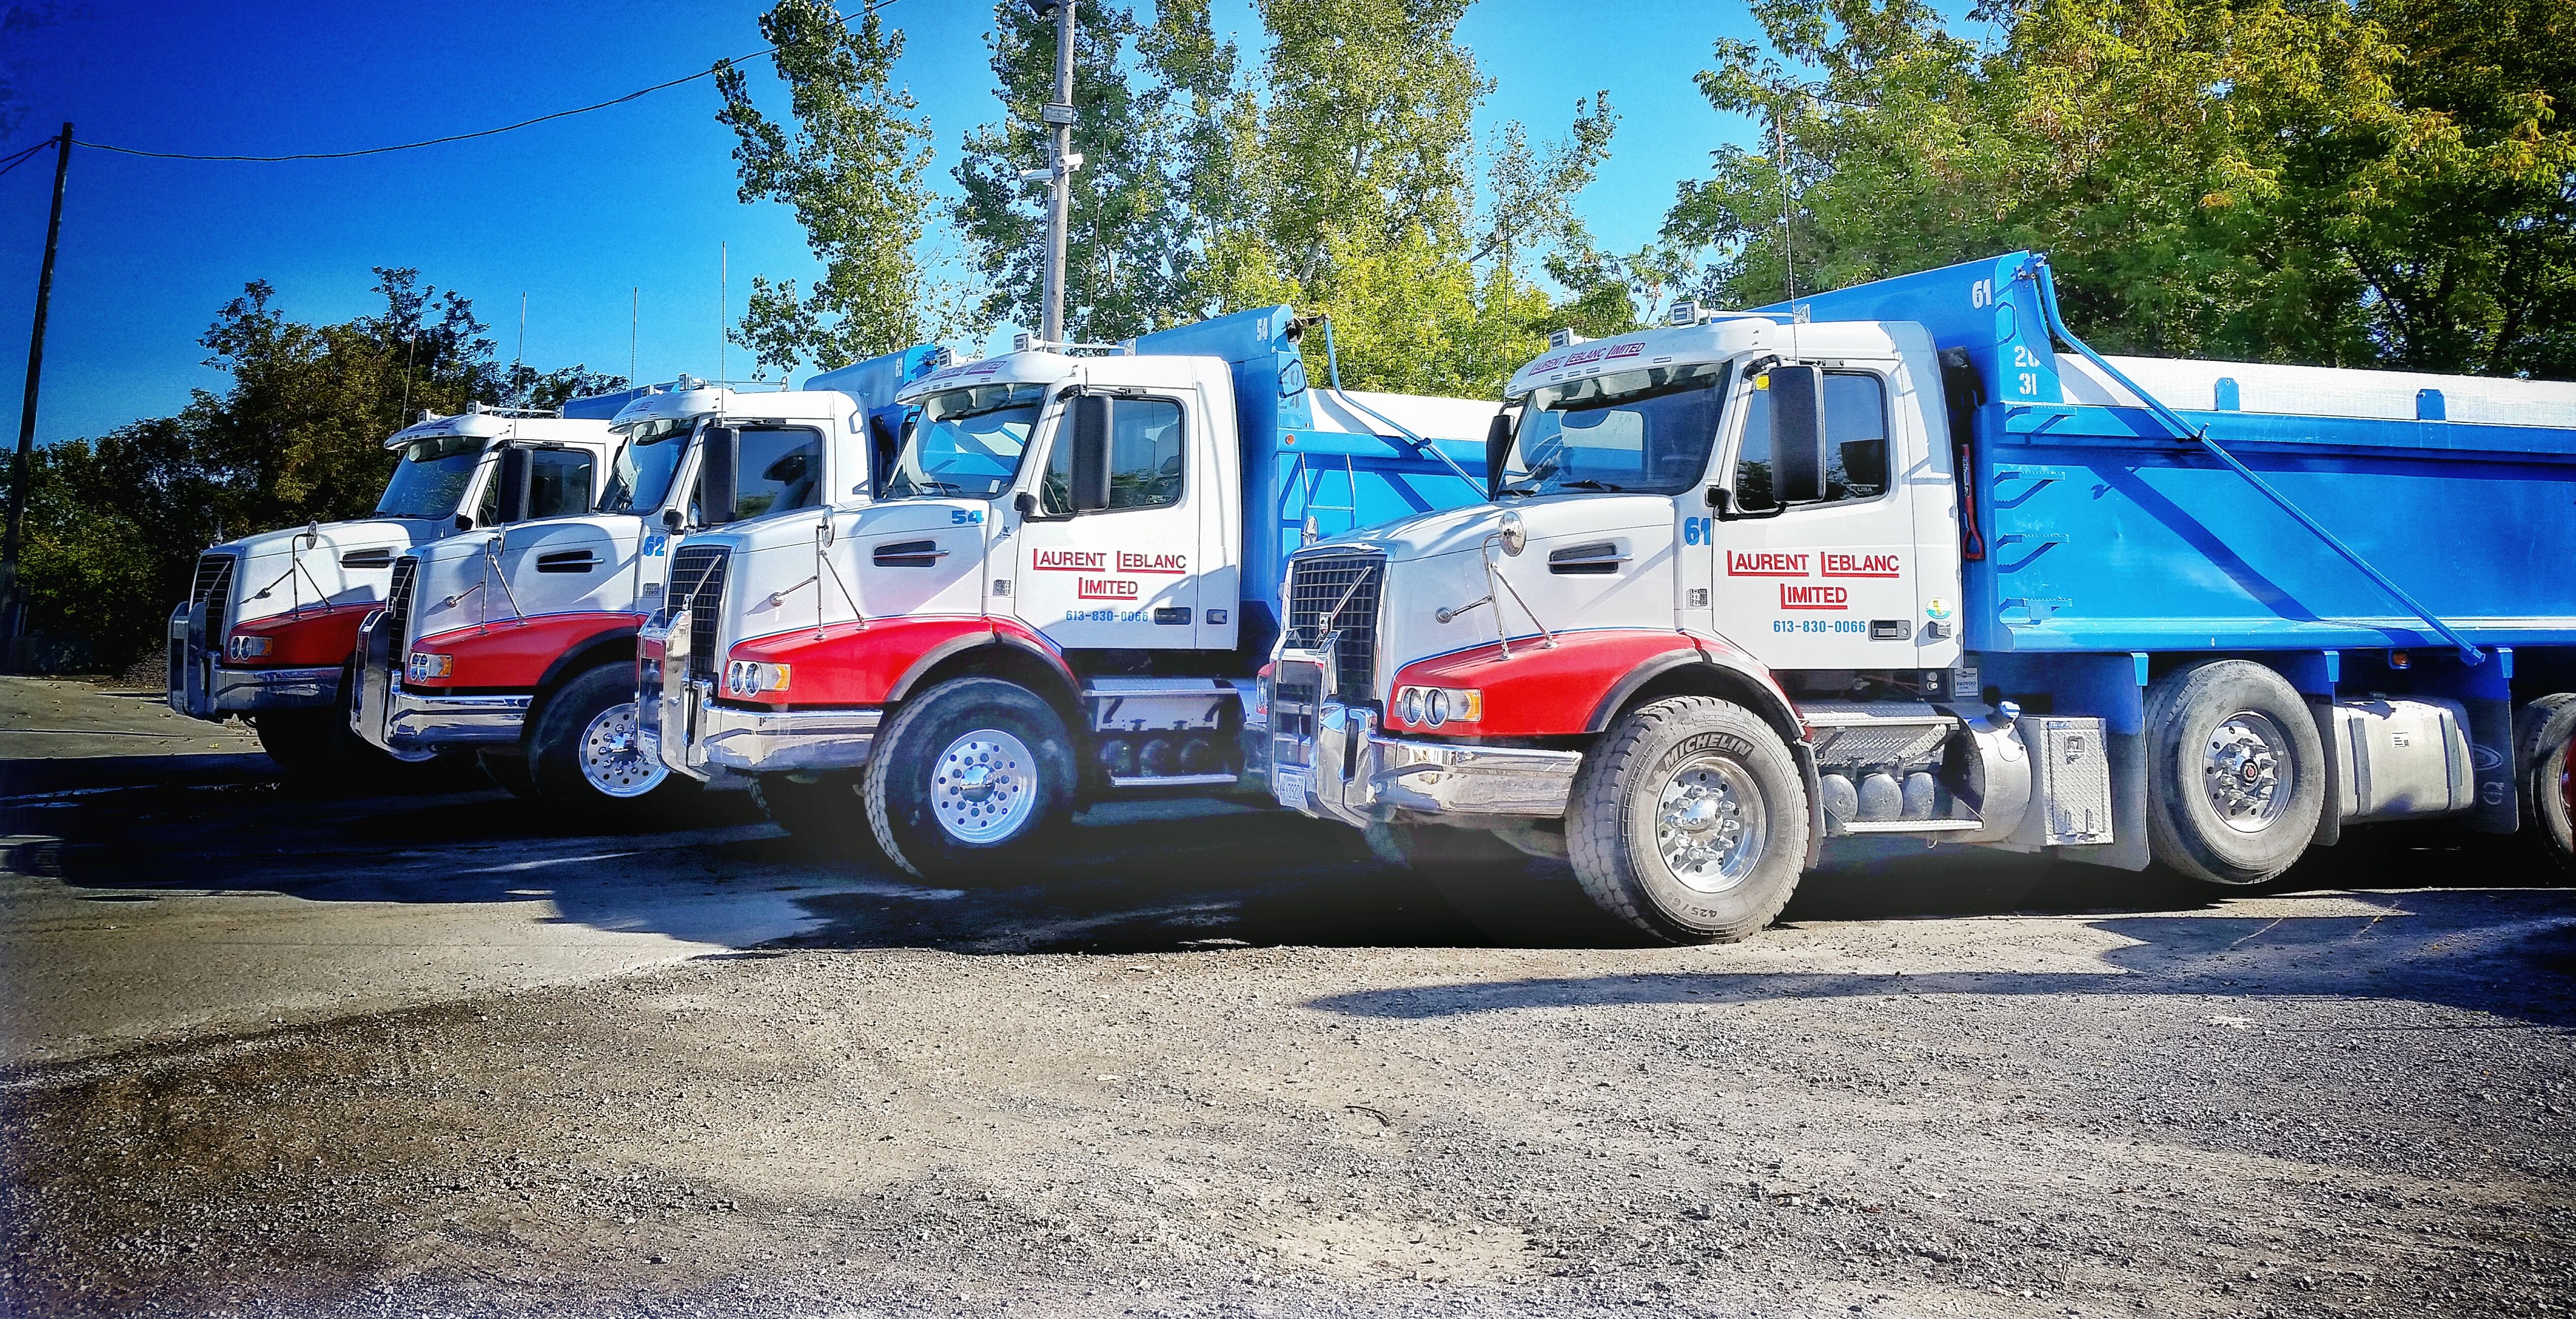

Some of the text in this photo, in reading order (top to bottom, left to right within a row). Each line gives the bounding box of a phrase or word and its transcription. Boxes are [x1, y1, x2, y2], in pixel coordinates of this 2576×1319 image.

[1972, 278, 1992, 309] 61
[1257, 318, 1268, 342] 54
[895, 357, 903, 378] 62
[1528, 342, 1646, 377] LAURENT LEBLANC LIMITED
[2019, 373, 2037, 395] 31
[952, 510, 984, 524] 54
[1685, 517, 1711, 545] 61
[643, 536, 665, 556] 62
[1034, 548, 1187, 574] LAURENT LEBLANC
[1727, 550, 1900, 578] LAURENT LEBLANC
[1079, 577, 1138, 600] LIMITED
[1780, 584, 1848, 609] LIMITED
[1066, 610, 1149, 623] 613-830-0066
[1773, 620, 1866, 633] 613-830-0066
[1664, 733, 1752, 771] MICHELIN
